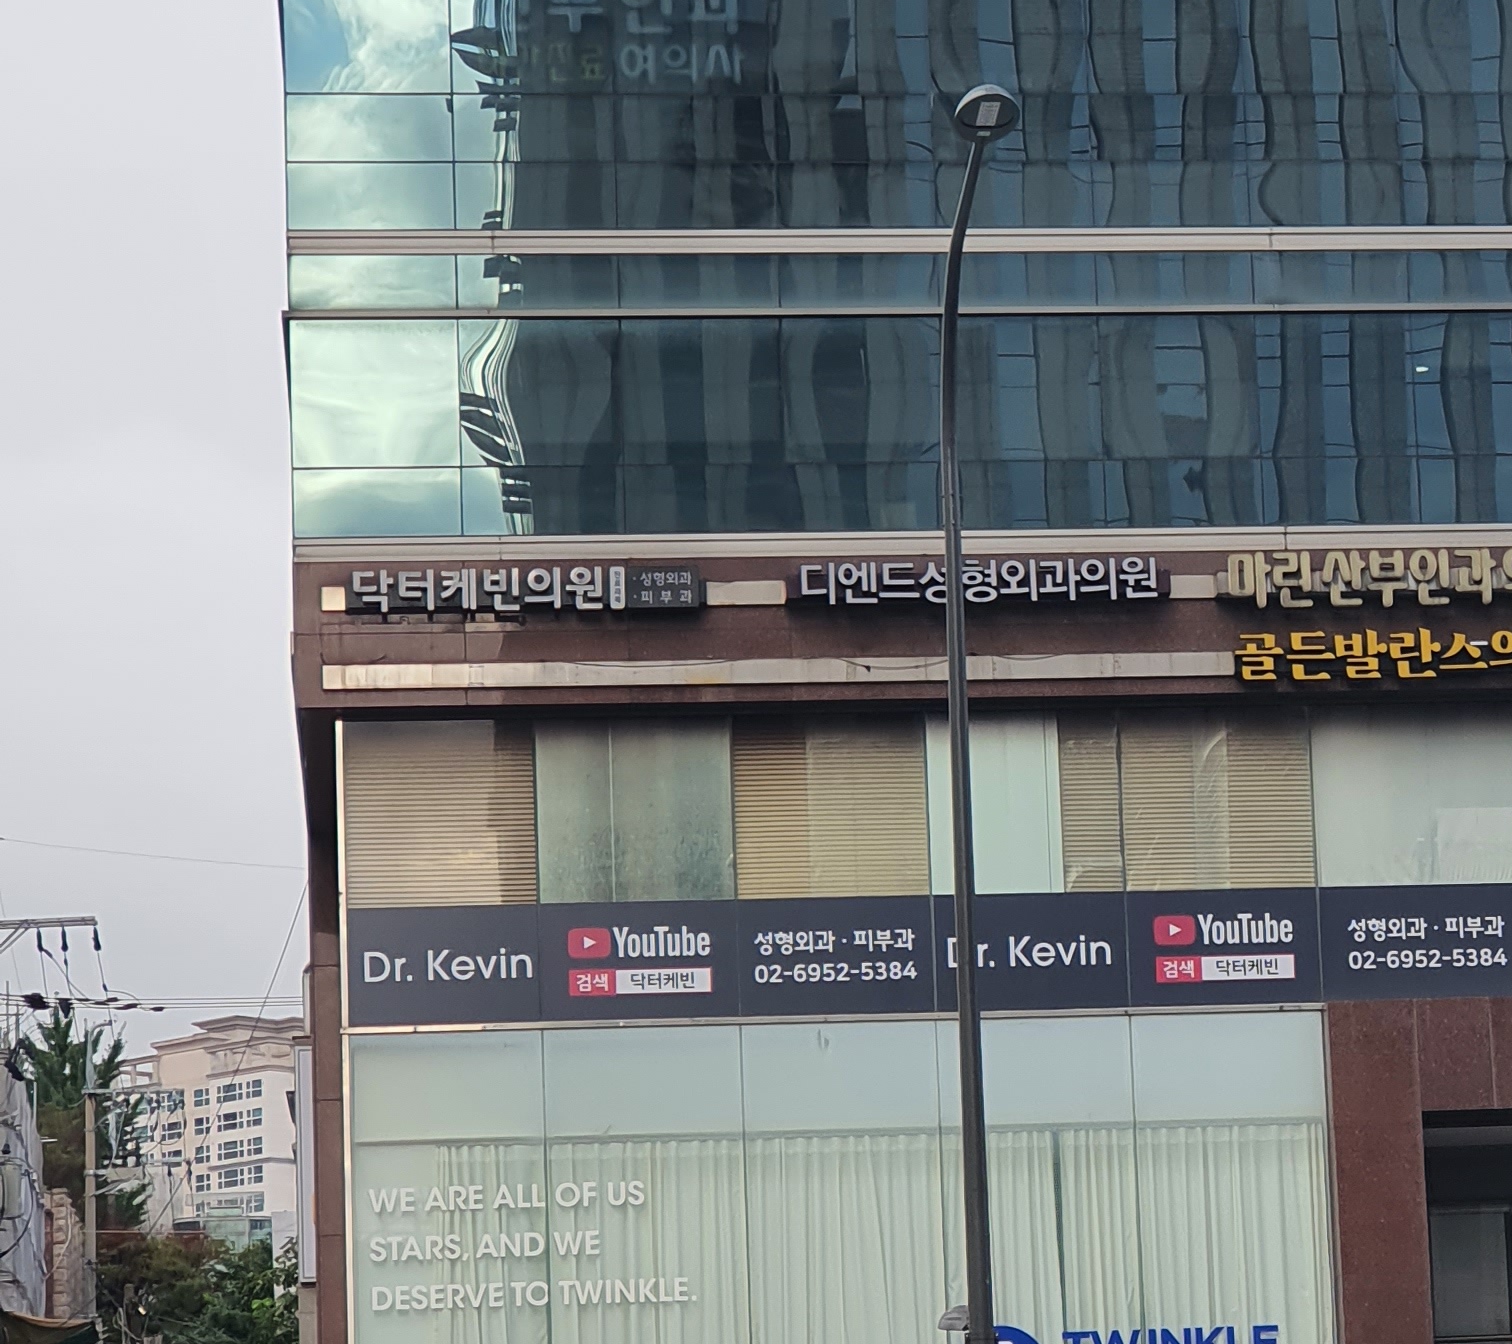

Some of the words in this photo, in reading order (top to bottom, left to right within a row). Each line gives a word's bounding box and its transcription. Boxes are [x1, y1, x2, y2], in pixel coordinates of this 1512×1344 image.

[352, 565, 604, 613] 닥터케빈의원
[640, 571, 692, 587] 성형외과
[800, 556, 1159, 605] 디엔드성형외과의원
[640, 589, 692, 605] 피부과
[613, 924, 712, 959] YouTube
[754, 931, 836, 956] 성형외과
[853, 928, 916, 953] 피부과
[1197, 911, 1294, 946] YouTube
[1347, 917, 1429, 942] 성형외과
[1444, 915, 1506, 940] 피부과
[362, 950, 414, 984] Dr.
[427, 947, 534, 982] Kevin
[1008, 933, 1113, 968] Kevin
[1348, 947, 1509, 971] 02-6952-5384
[576, 972, 610, 992] 검색
[630, 970, 696, 990] 닥터케빈
[754, 961, 918, 985] 02-6952-5384
[1162, 959, 1195, 979] 검색
[1215, 958, 1280, 978] 닥터케빈
[368, 1187, 415, 1213] WE
[424, 1184, 484, 1212] ARE
[493, 1182, 546, 1210] ALL
[555, 1180, 597, 1209] OF
[607, 1179, 646, 1207] US
[369, 1233, 470, 1263] STARS,
[475, 1231, 546, 1260] AND
[553, 1229, 601, 1257] WE
[371, 1280, 504, 1311] DESERVE
[510, 1280, 549, 1308] TO
[558, 1276, 698, 1306] TWINKLE.
